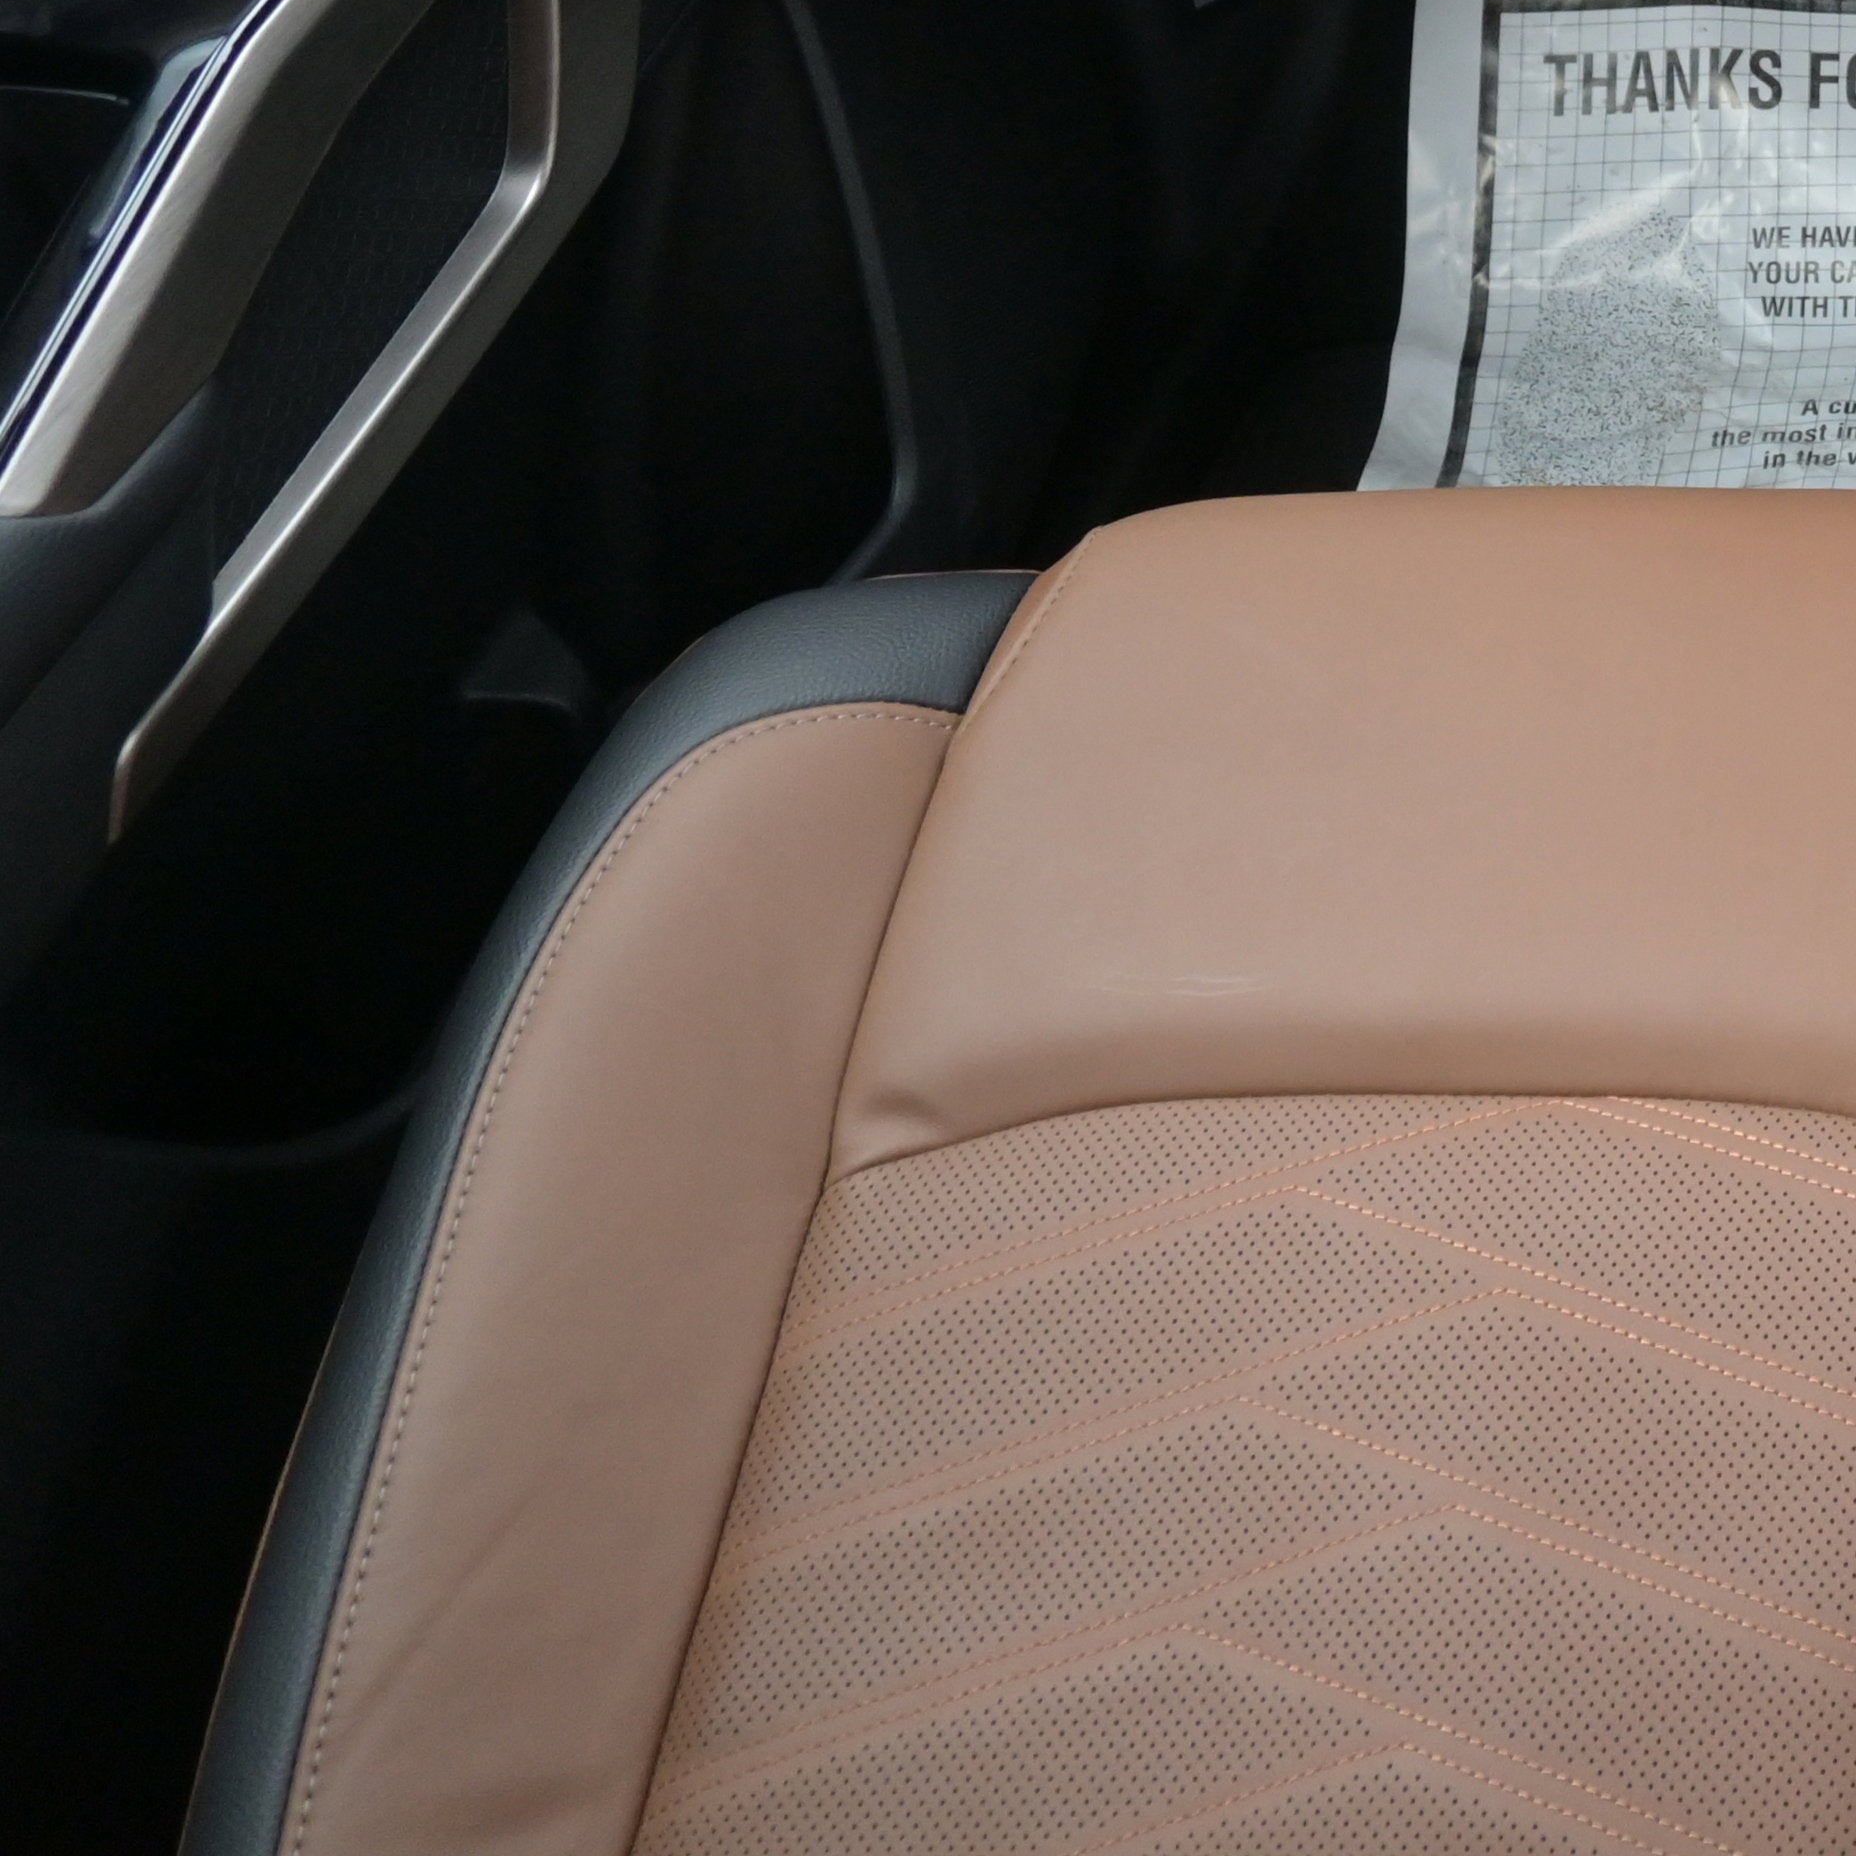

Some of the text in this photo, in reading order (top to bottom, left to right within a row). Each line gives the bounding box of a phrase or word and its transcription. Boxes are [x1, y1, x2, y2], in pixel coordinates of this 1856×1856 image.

[1544, 48, 1782, 116] THANKS
[1752, 226, 1791, 250] WE
[1749, 260, 1820, 285] YOUR
[1761, 295, 1829, 318] WITH
[1800, 399, 1819, 416] A
[1712, 429, 1751, 448] the
[1761, 424, 1827, 443] most
[1763, 451, 1785, 469] in
[1797, 449, 1837, 466] the
